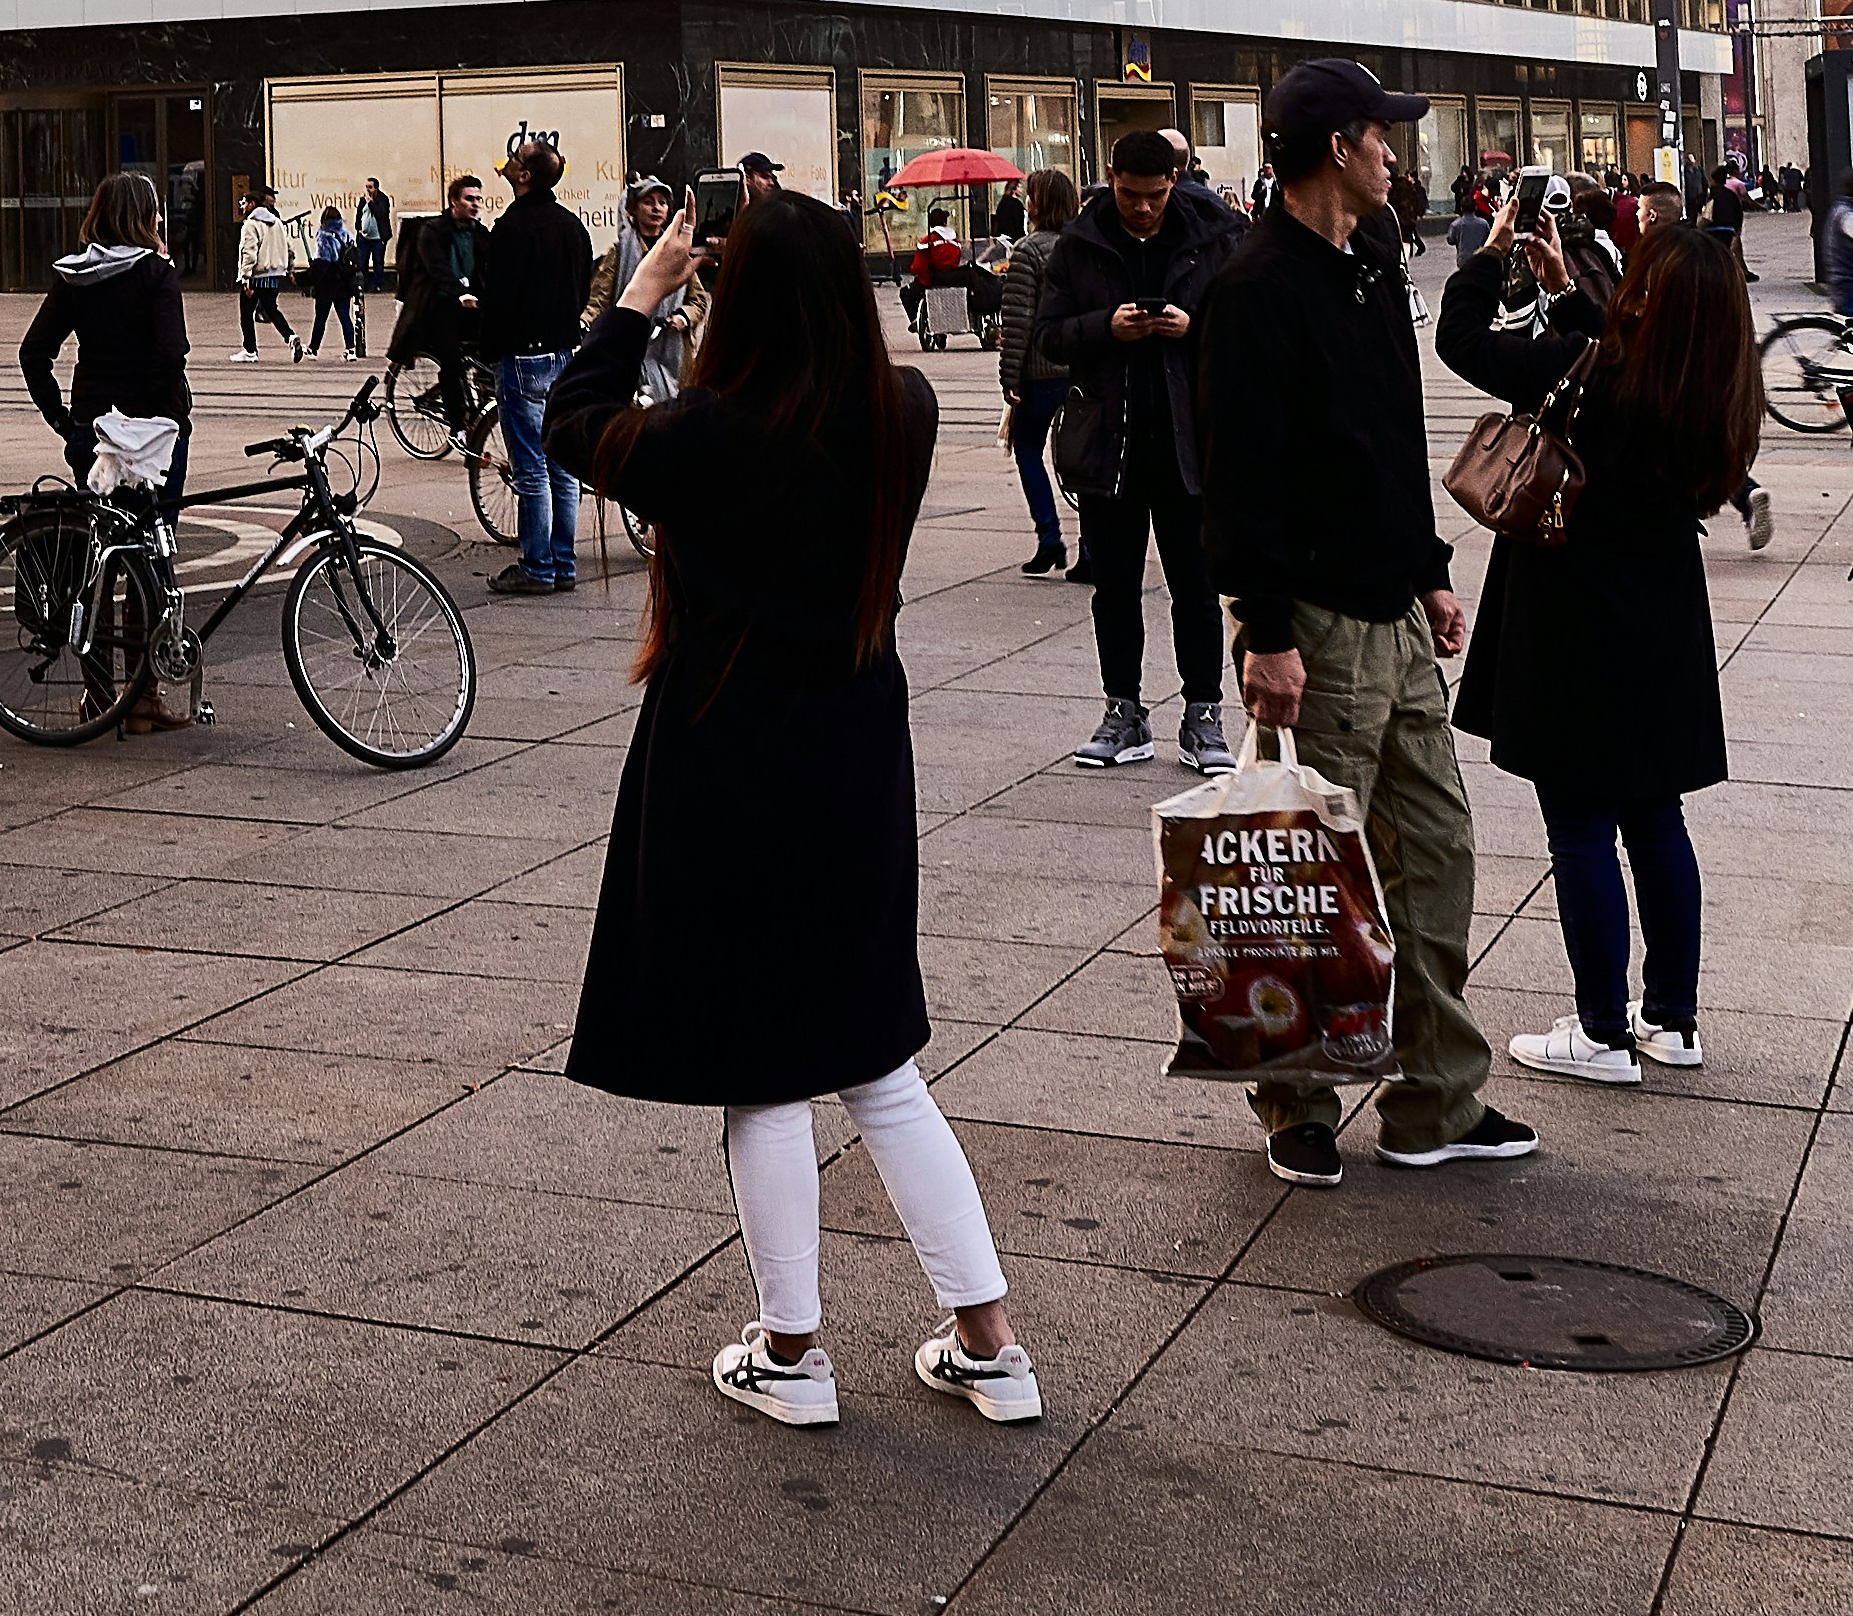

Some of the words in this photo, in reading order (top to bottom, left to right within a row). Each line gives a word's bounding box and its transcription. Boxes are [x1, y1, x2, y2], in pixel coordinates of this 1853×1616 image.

[507, 121, 559, 155] dm
[310, 191, 395, 210] Wohlfün
[1201, 829, 1342, 865] ACKERN
[1249, 866, 1285, 883] FÜR
[1198, 885, 1340, 916] FRISCHE
[1210, 919, 1330, 935] FELDVORTEILE.
